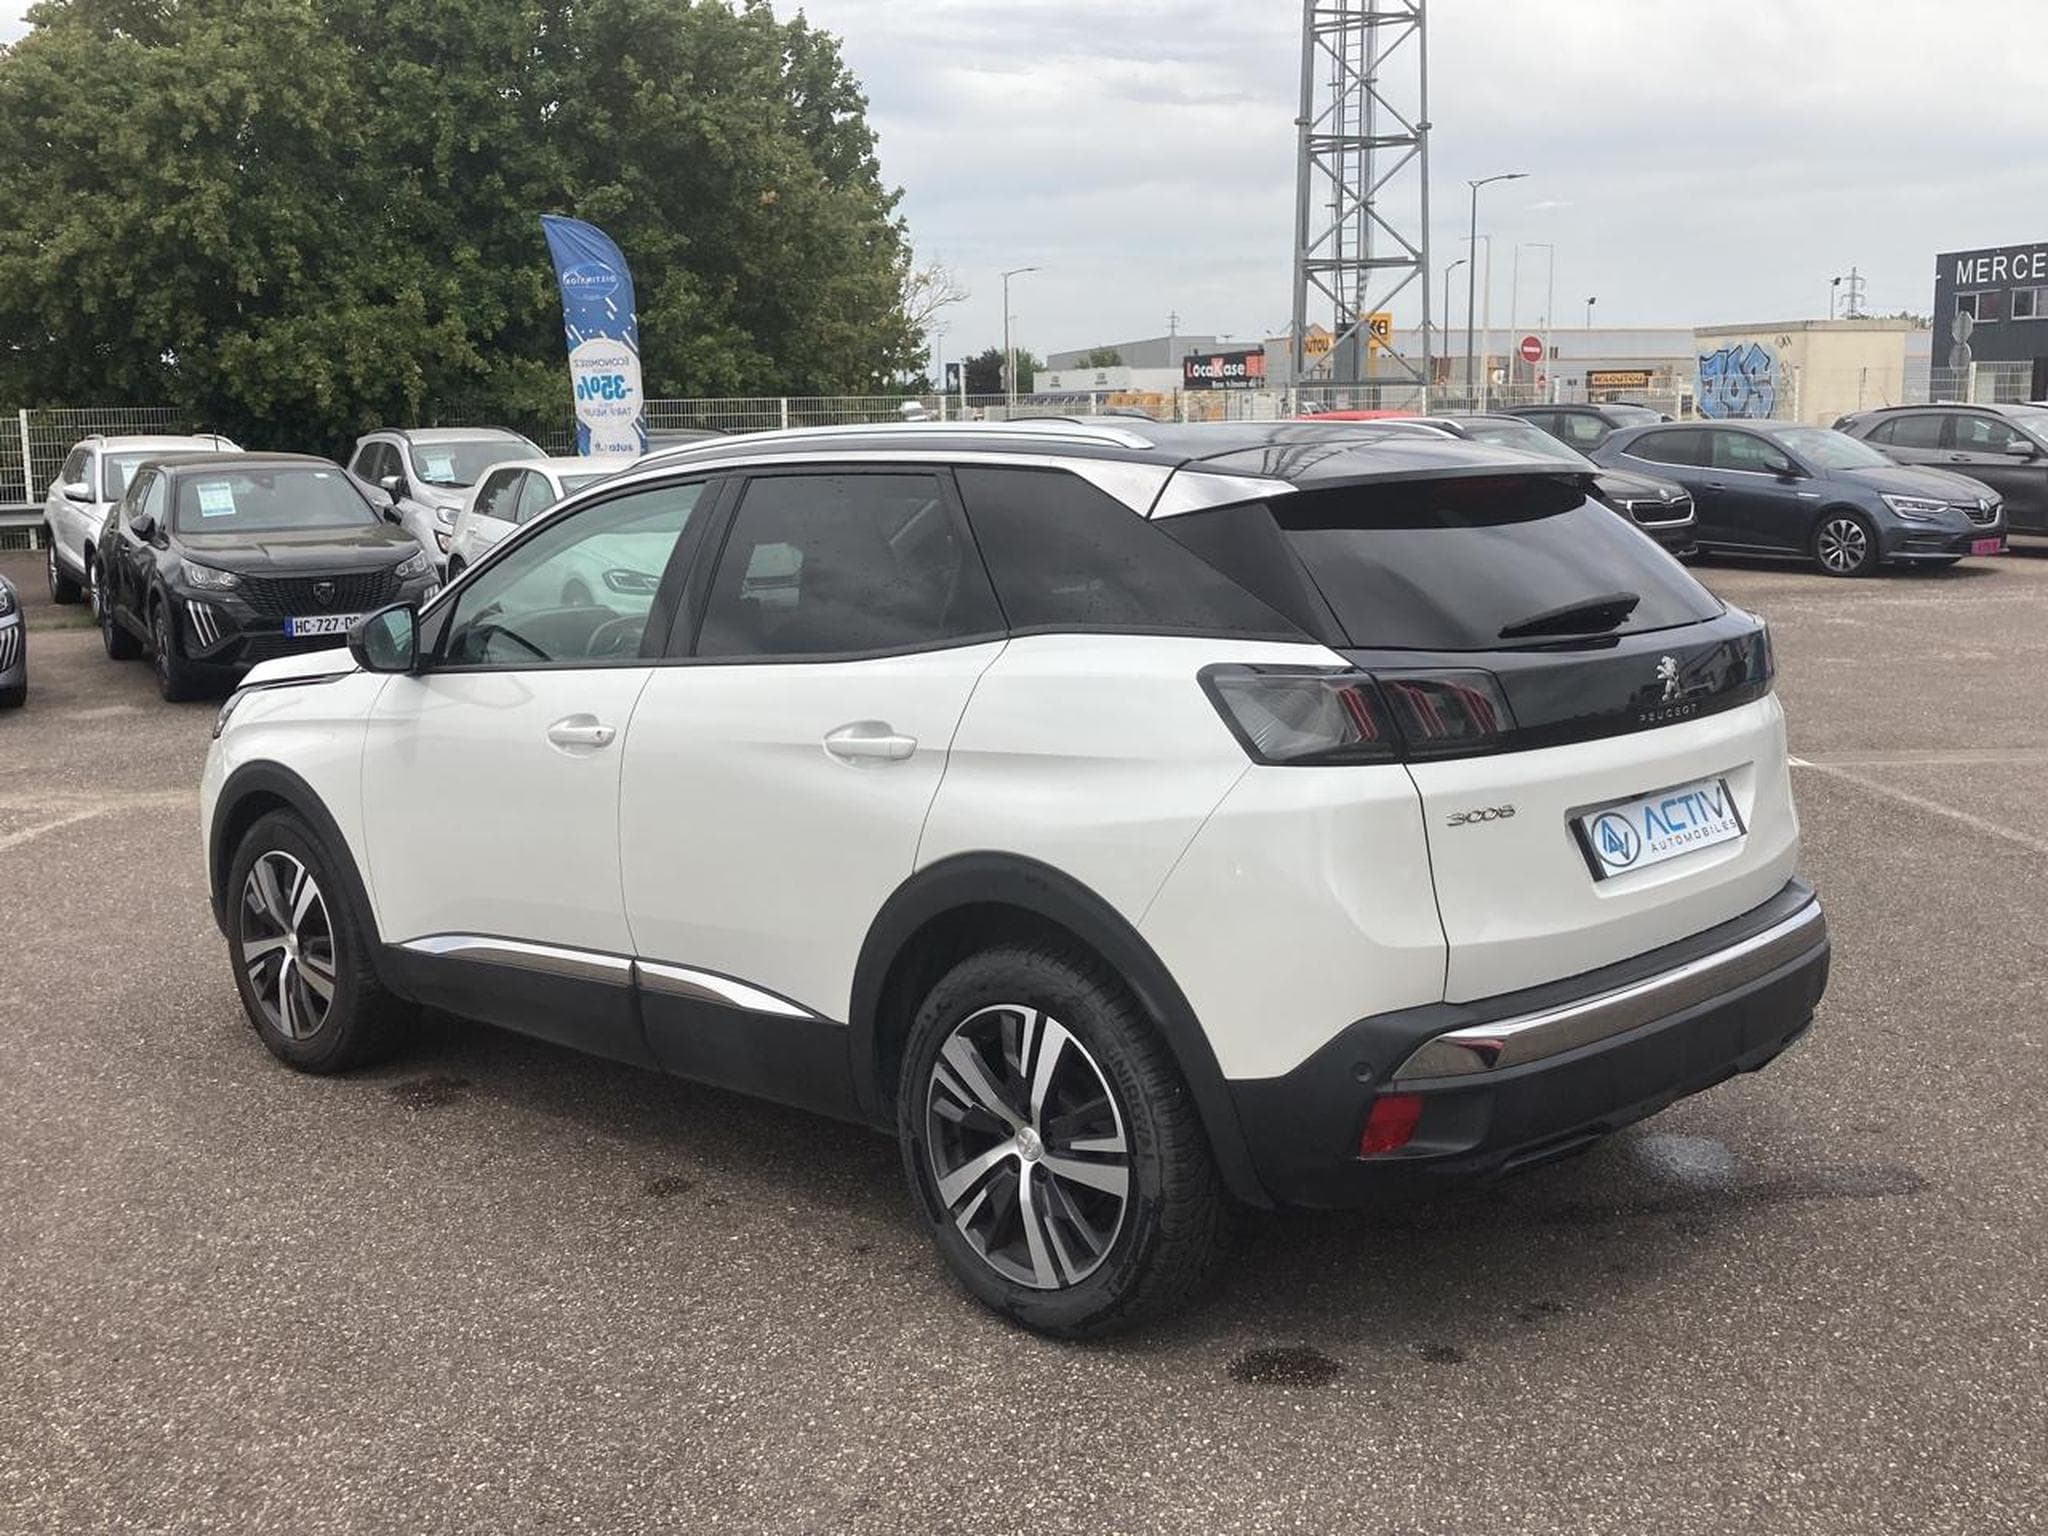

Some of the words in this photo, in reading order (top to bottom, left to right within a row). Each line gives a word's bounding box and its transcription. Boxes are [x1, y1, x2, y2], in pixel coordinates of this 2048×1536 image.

[1956, 253, 2047, 285] MERCE
[1639, 703, 1697, 721] PEUGEOT
[1446, 804, 1516, 826] 3008
[1644, 786, 1722, 841] ACTIV
[1651, 818, 1738, 853] AUTOMOBILES
